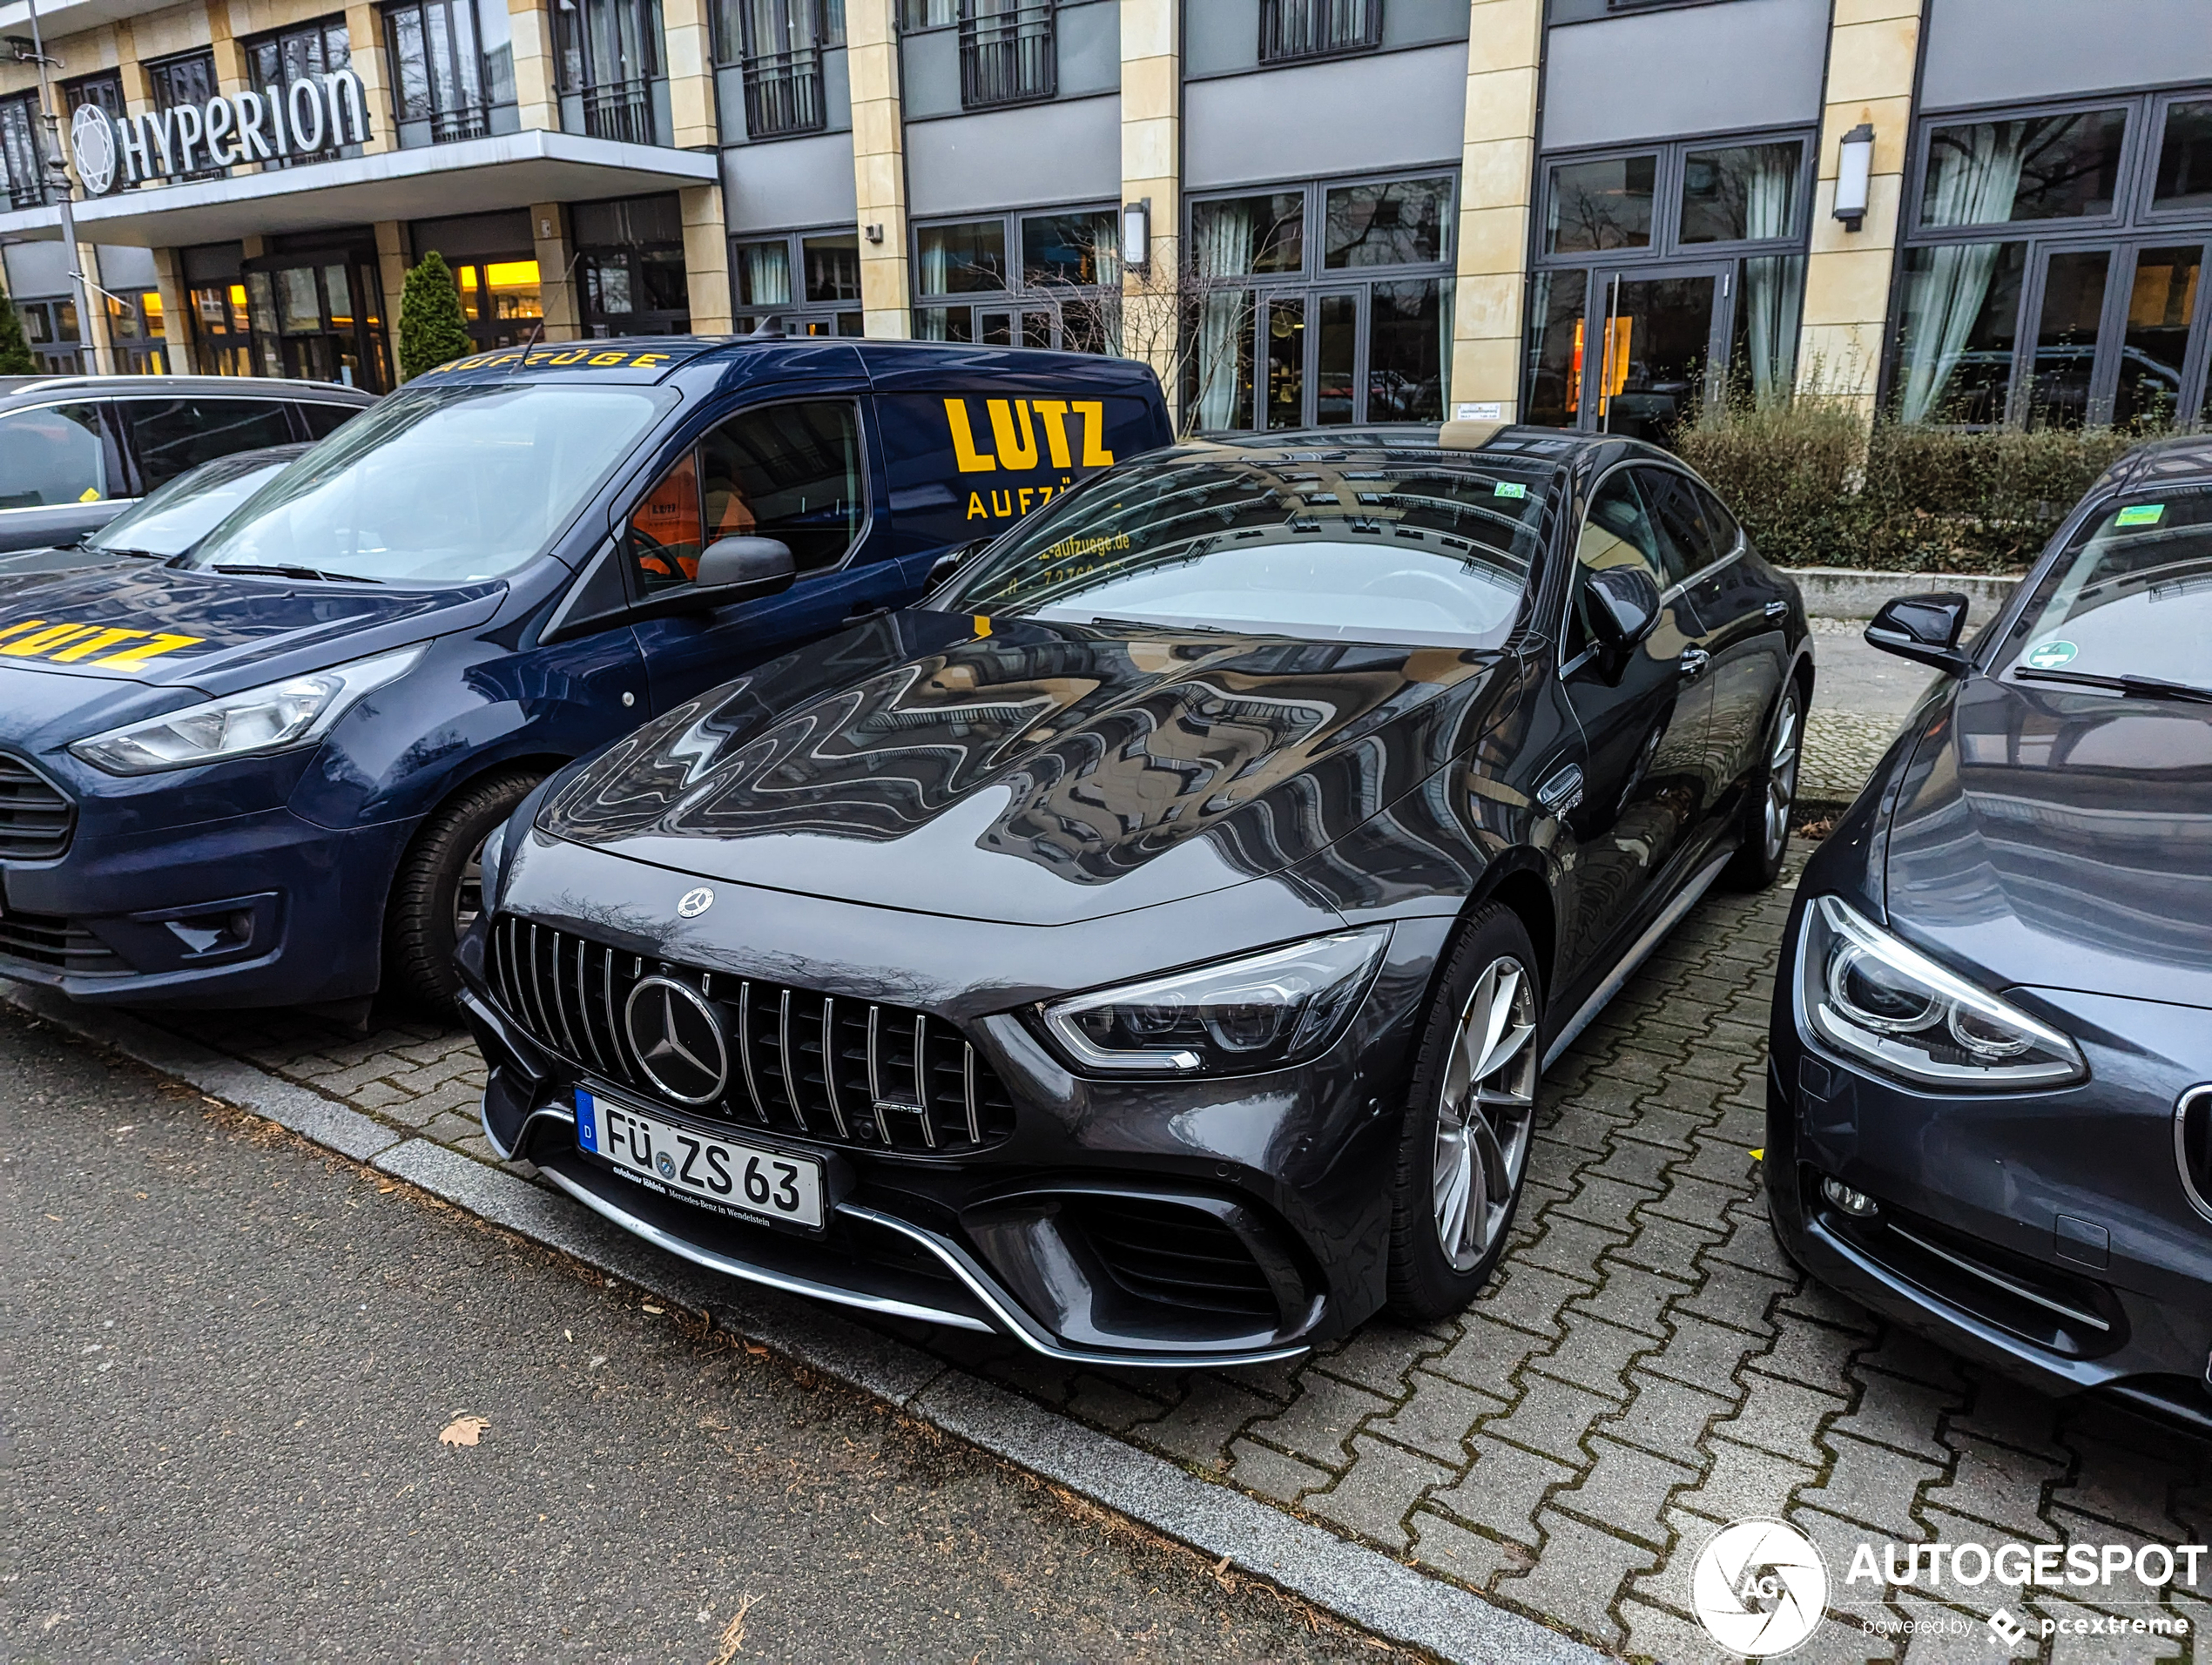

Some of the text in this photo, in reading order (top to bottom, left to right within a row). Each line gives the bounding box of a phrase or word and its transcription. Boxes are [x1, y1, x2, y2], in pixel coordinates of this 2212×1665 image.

[428, 349, 671, 374] AUFZÜGE
[943, 399, 1114, 472] LUTZ
[967, 477, 1070, 520] AUFZ
[584, 1124, 592, 1139] D
[606, 1108, 653, 1170] FÜ
[677, 1135, 733, 1195] ZS
[744, 1155, 800, 1213] 63
[669, 1189, 718, 1213] Mercedes-Benz
[718, 1204, 726, 1215] in
[726, 1207, 771, 1227] Wendelstein
